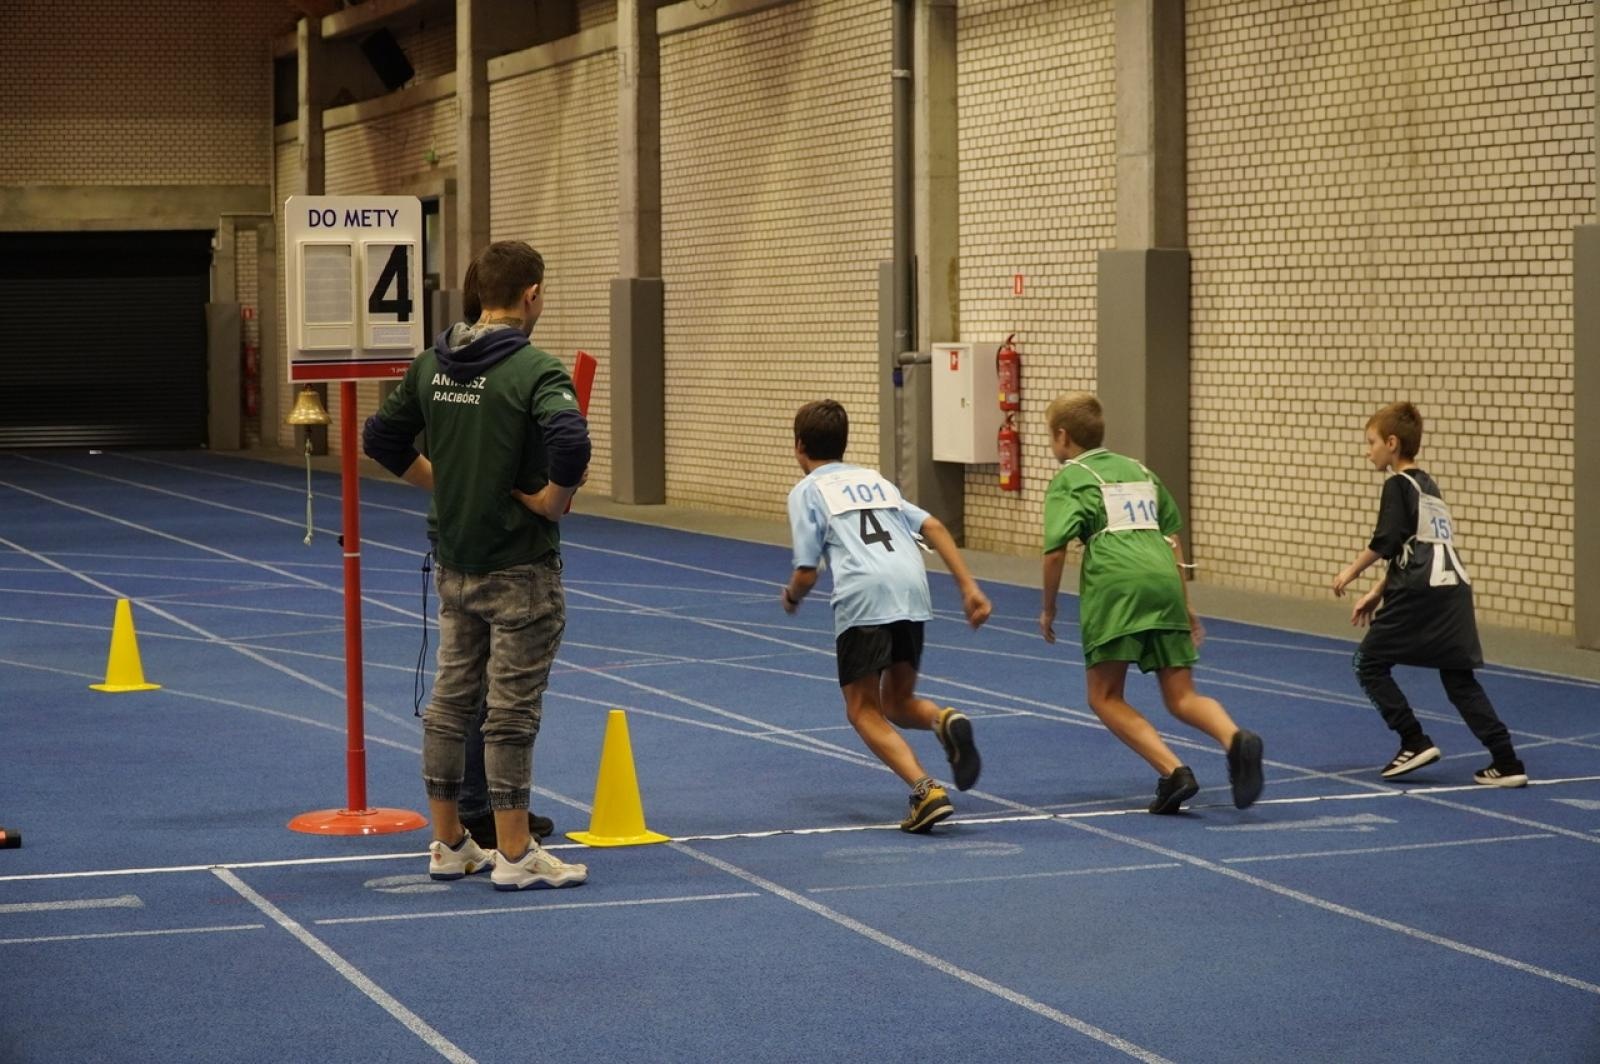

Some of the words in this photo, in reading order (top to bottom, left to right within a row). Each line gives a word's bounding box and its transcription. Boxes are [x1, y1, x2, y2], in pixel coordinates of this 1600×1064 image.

[308, 209, 337, 228] DO
[343, 209, 400, 228] METY
[368, 245, 413, 322] 4
[431, 373, 487, 389] ANUSZ
[433, 391, 481, 405] RACIBÓRZ
[842, 482, 887, 504] 101
[859, 509, 896, 552] 4
